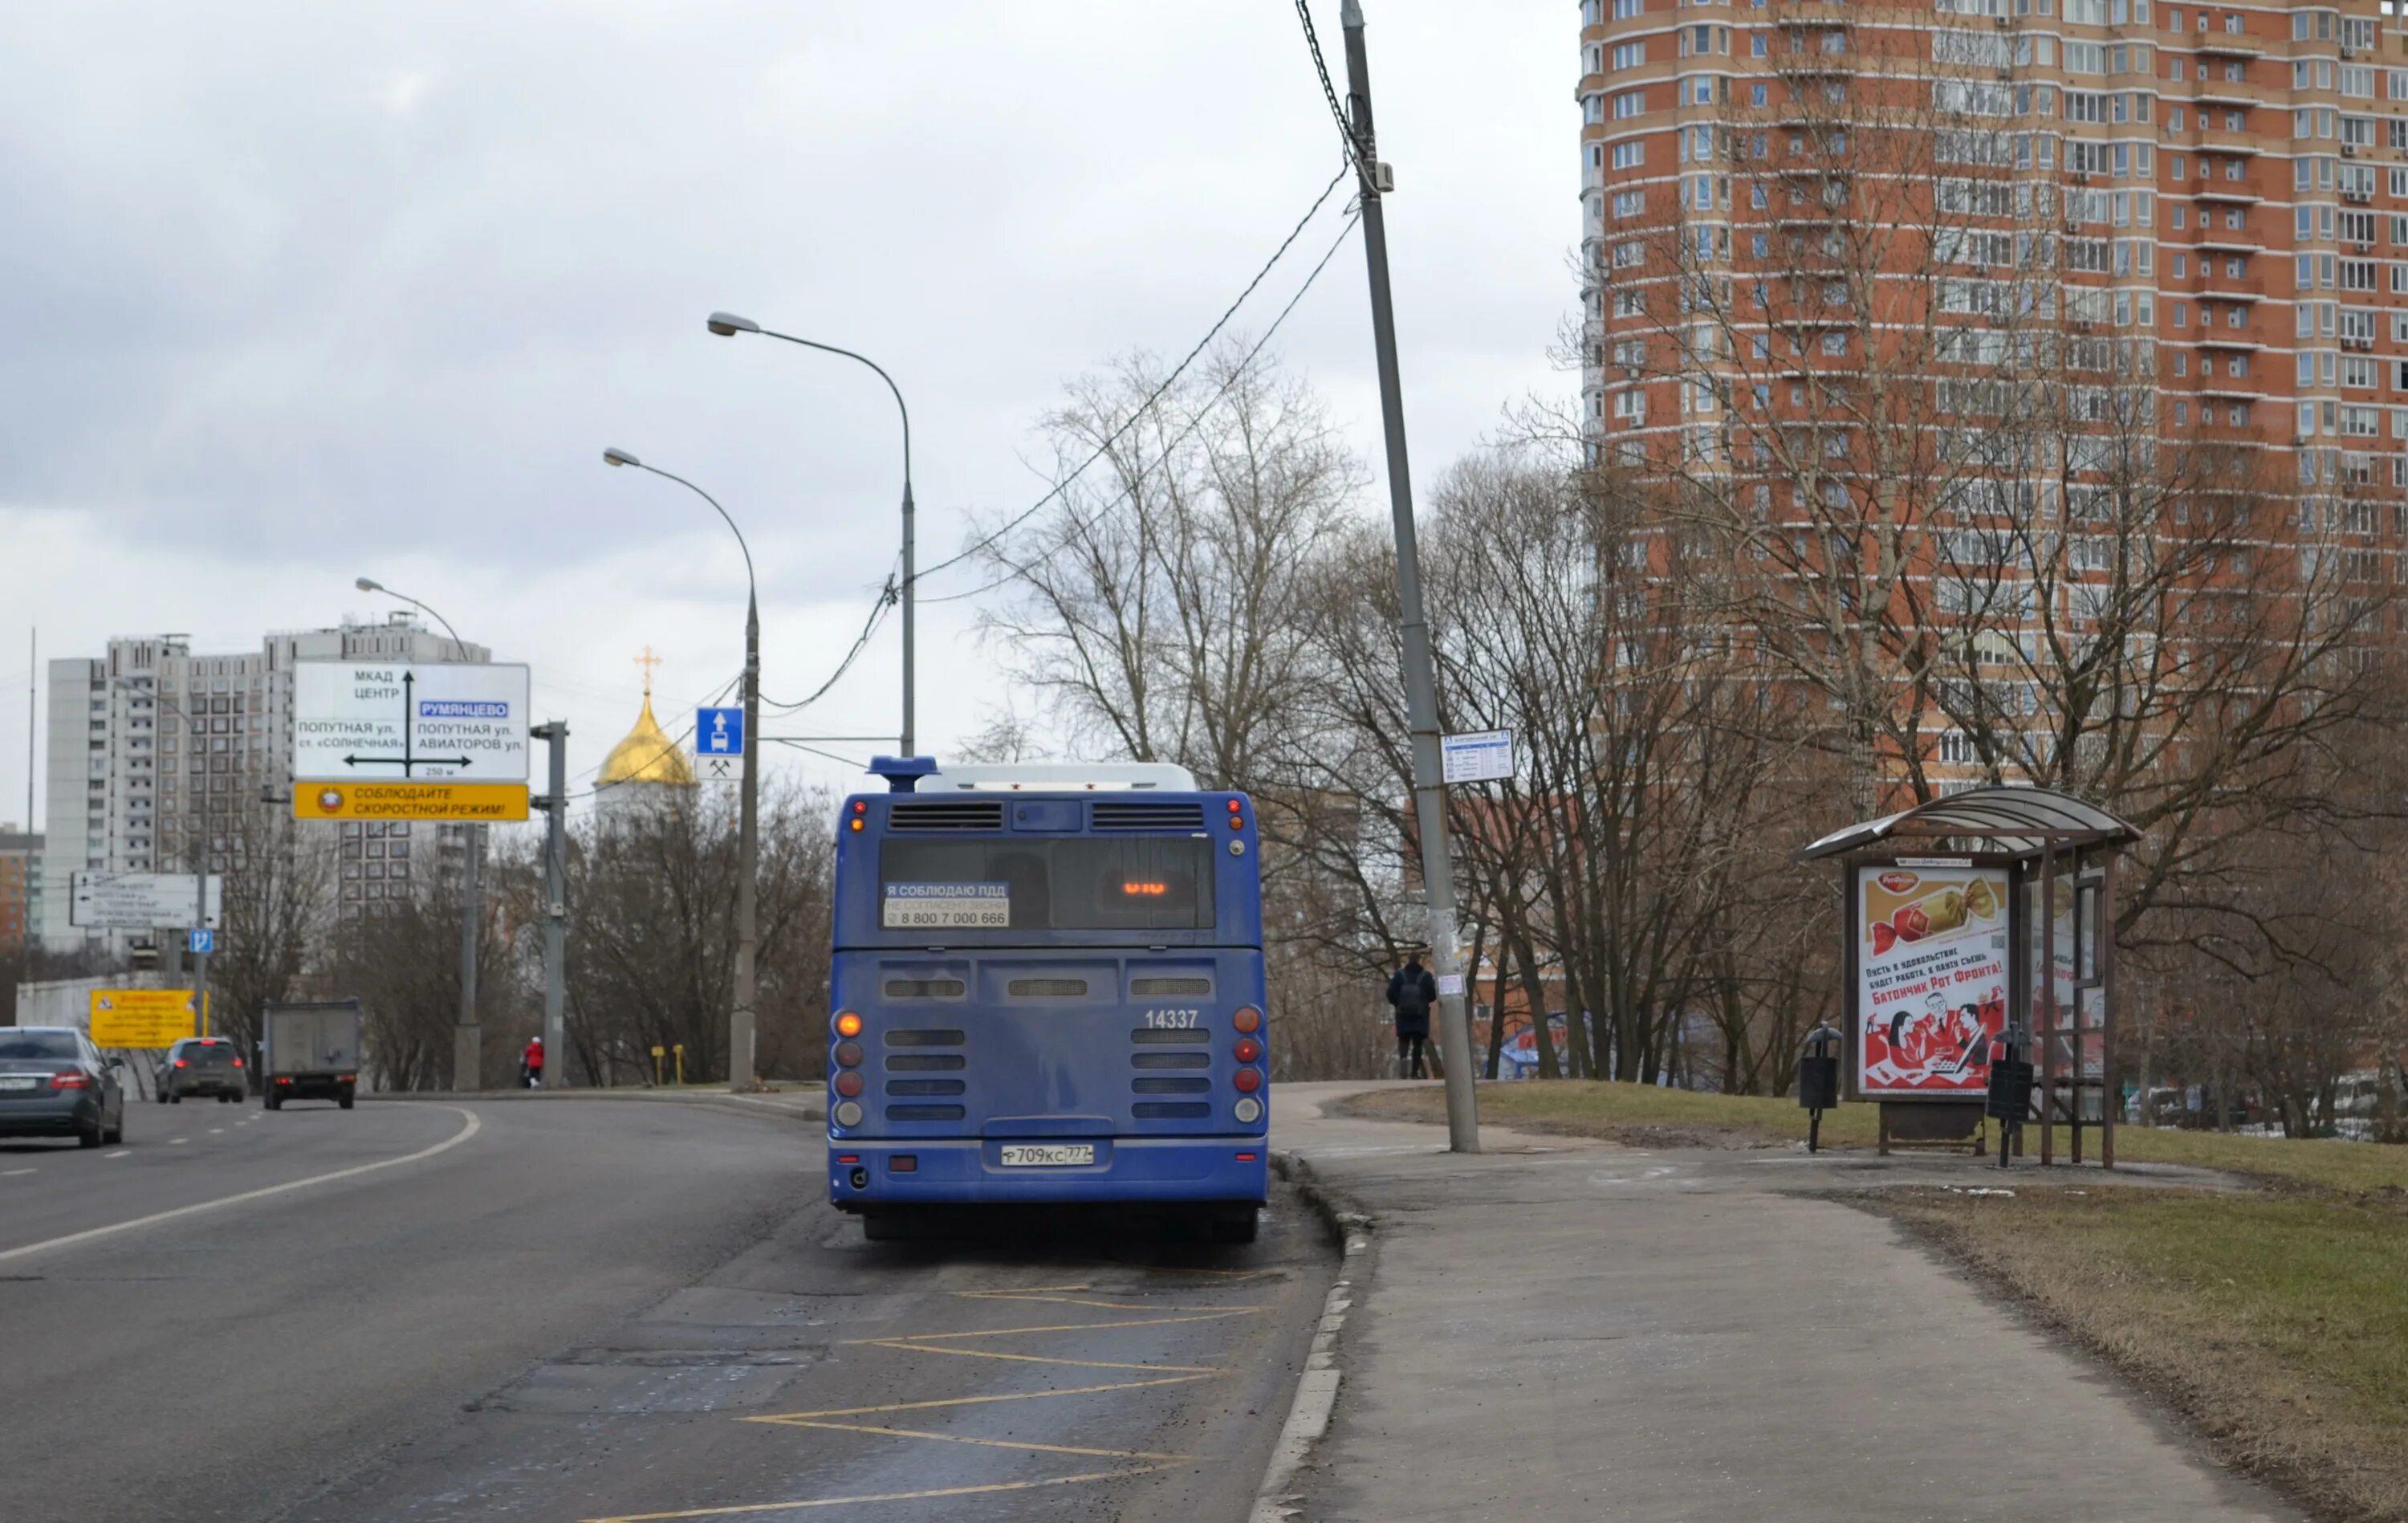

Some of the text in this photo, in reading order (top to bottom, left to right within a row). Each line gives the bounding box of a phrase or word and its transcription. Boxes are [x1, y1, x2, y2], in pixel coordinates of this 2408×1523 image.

[355, 671, 393, 682] МКАД
[355, 688, 399, 699] ЦЕНТР
[421, 702, 506, 716] РУМЯНЦЕВО
[299, 723, 396, 735] ПОПУТНАЯ ул.
[417, 724, 513, 737] ПОПУТНАЯ ул.
[317, 738, 405, 747] «СОЛНЕЧНАЯ»
[418, 739, 523, 751] АВИАТОРОВ ул.
[425, 768, 443, 776] 250
[354, 788, 452, 800] СОБЛЮДАЙТЕ
[354, 803, 505, 814] СКОРОСТНОЙ РЕЖИМ!
[887, 886, 1005, 897] Я СОБЛЮДАЮ ПДД
[887, 901, 1006, 910] НЕ СОГЛАСЕН? ЗВОНИ
[901, 913, 1005, 923] 8 800 7 000 666
[1872, 960, 2003, 1005] Батончик Рот Фронта!
[1145, 1010, 1198, 1028] 14337
[1066, 1146, 1088, 1157] 777
